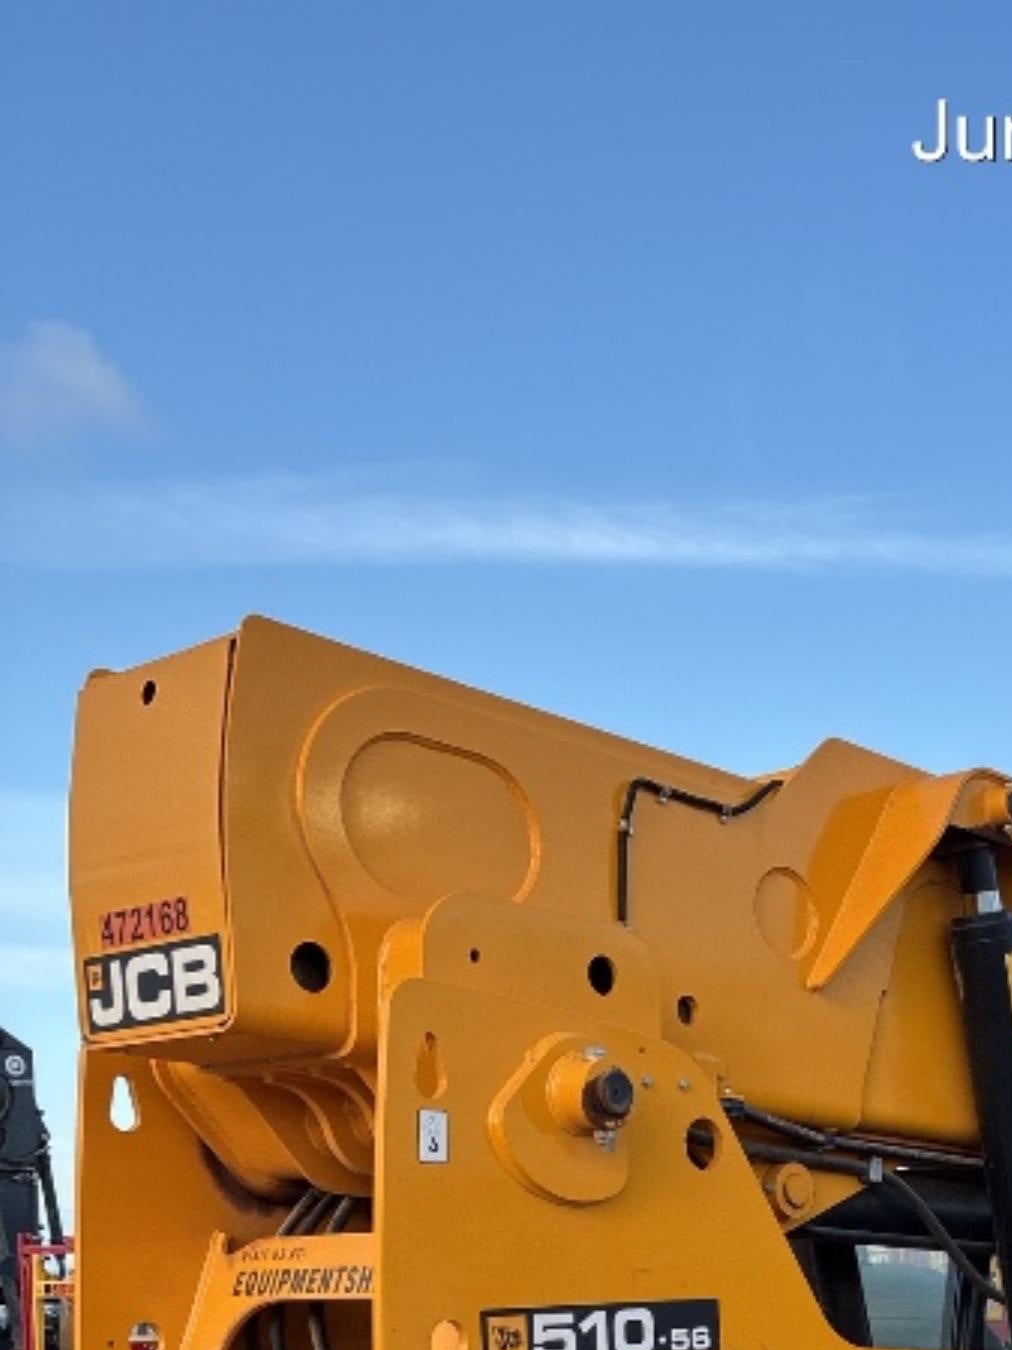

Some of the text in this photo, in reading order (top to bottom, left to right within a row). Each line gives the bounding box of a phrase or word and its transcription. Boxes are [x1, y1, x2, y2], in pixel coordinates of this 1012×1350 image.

[101, 897, 189, 945] 472168
[90, 944, 221, 1027] JCB
[232, 1265, 374, 1297] EQUIPMENTSH
